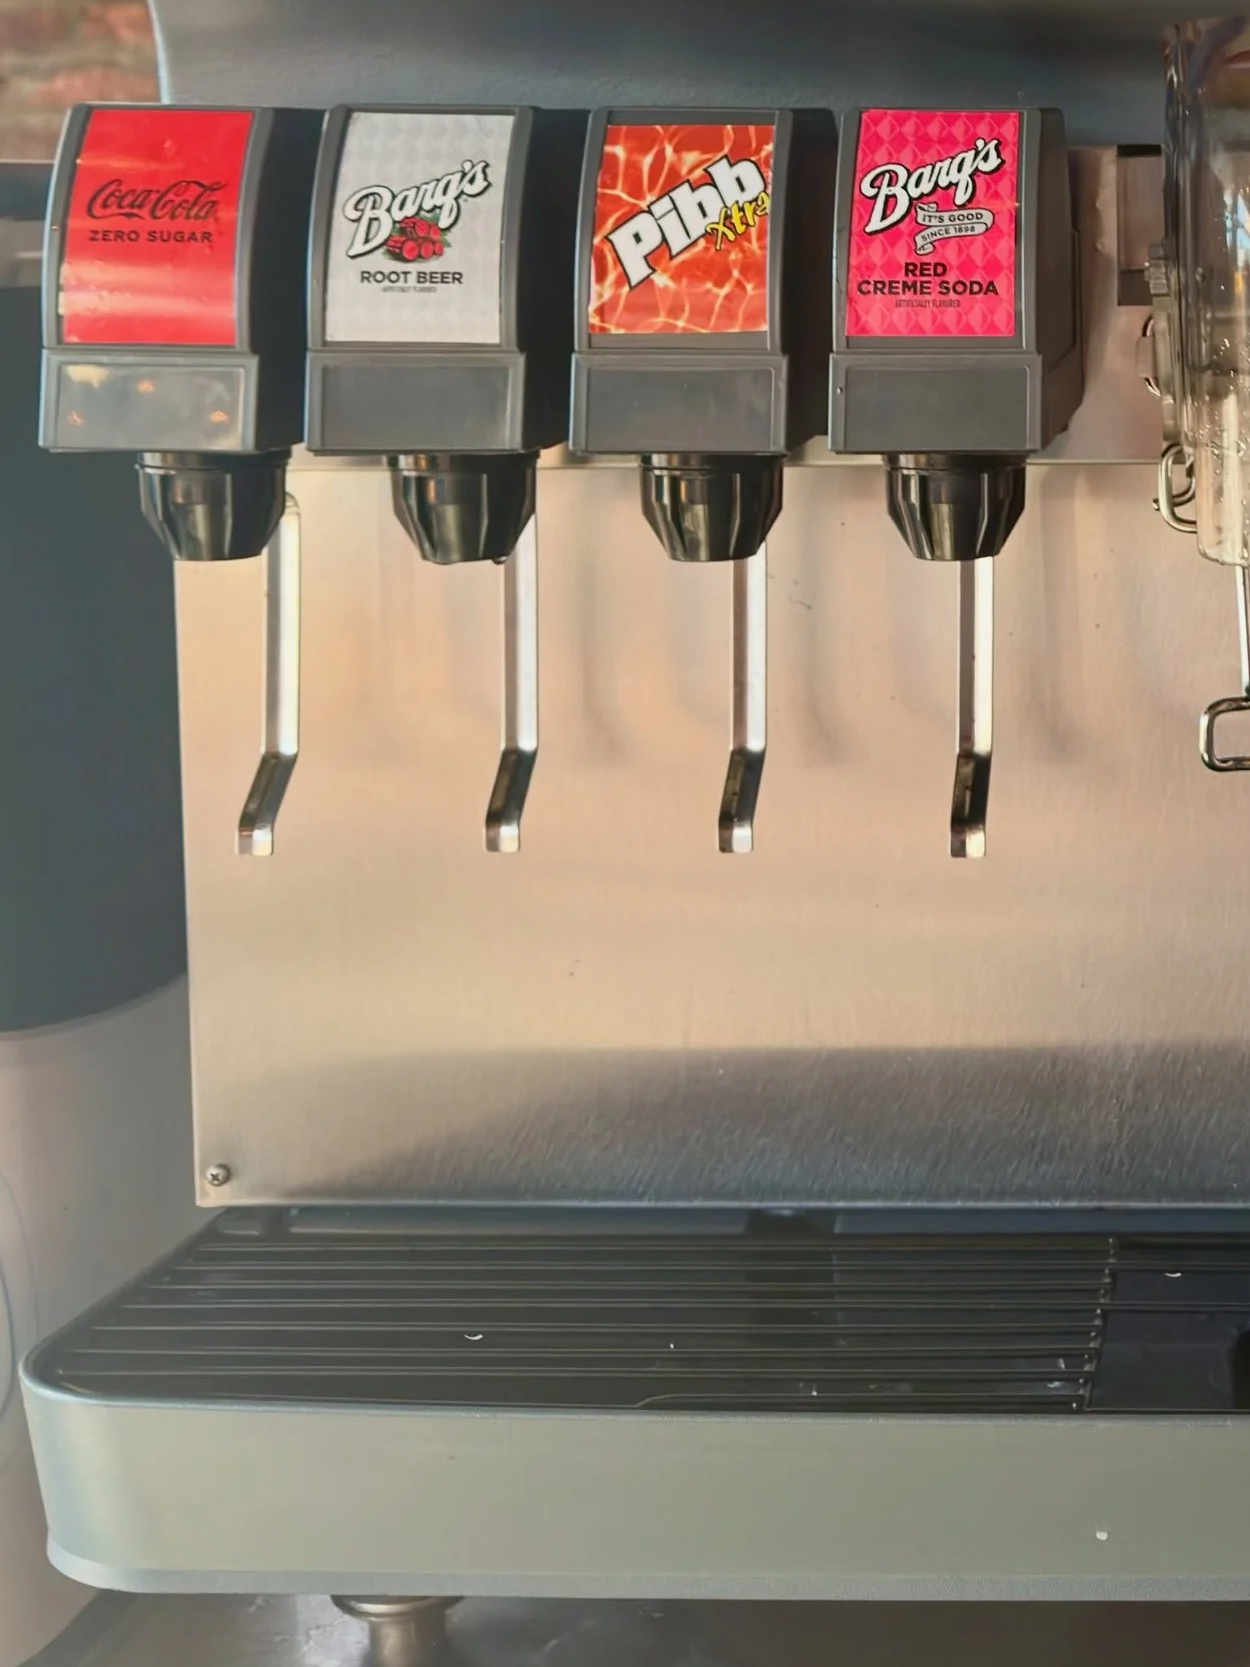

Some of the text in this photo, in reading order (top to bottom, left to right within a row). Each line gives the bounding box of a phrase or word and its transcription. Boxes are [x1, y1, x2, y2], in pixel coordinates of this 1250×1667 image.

[860, 137, 1006, 235] Barq's
[87, 178, 228, 221] Coca-Cola
[342, 159, 493, 260] Barq's
[921, 212, 985, 224] IT'S GOOD
[607, 154, 767, 291] Pibb
[88, 229, 213, 244] ZERO SUGAR
[920, 224, 977, 243] SINCE 1898
[360, 270, 464, 285] ROOT BEER
[904, 261, 948, 277] RED
[857, 279, 999, 296] CREME SODA
